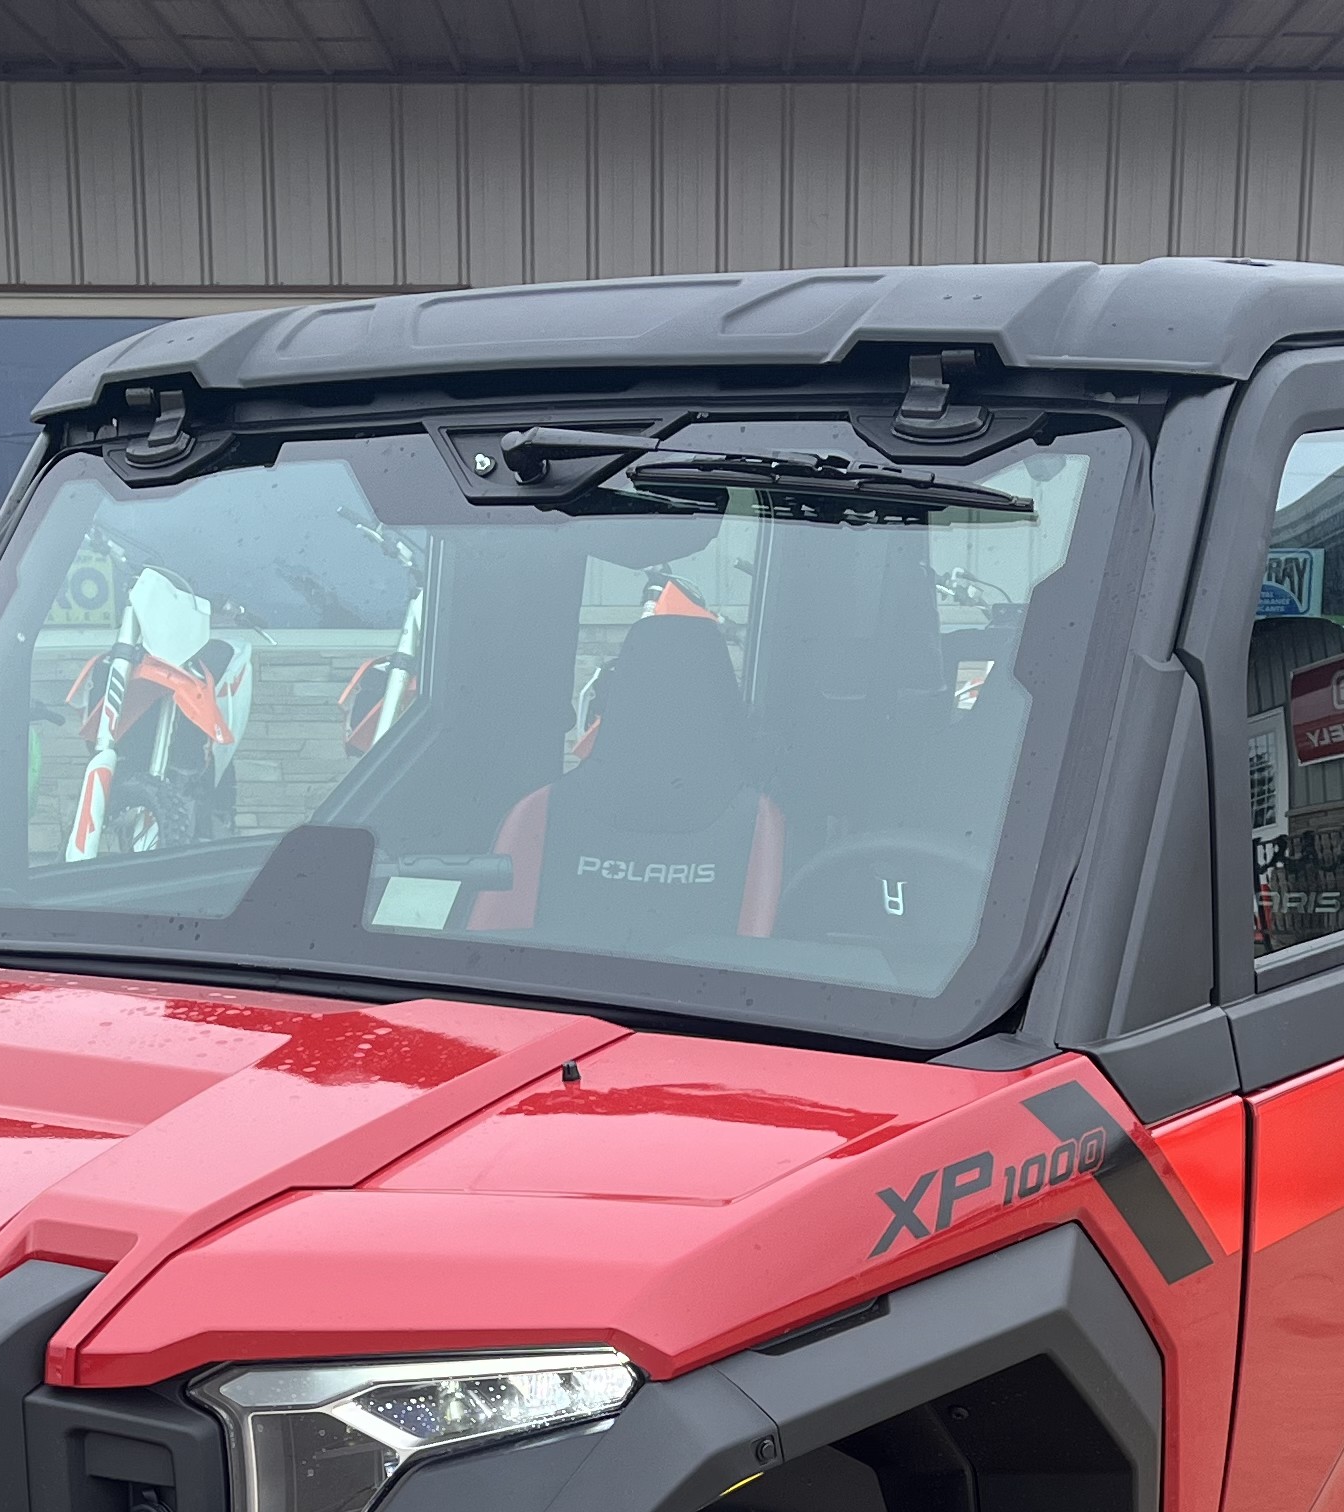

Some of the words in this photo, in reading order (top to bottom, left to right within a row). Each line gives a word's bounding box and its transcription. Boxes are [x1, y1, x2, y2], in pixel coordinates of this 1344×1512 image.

[577, 855, 716, 884] POLARIS
[867, 1150, 996, 1260] XP
[1002, 1126, 1109, 1208] 1000
